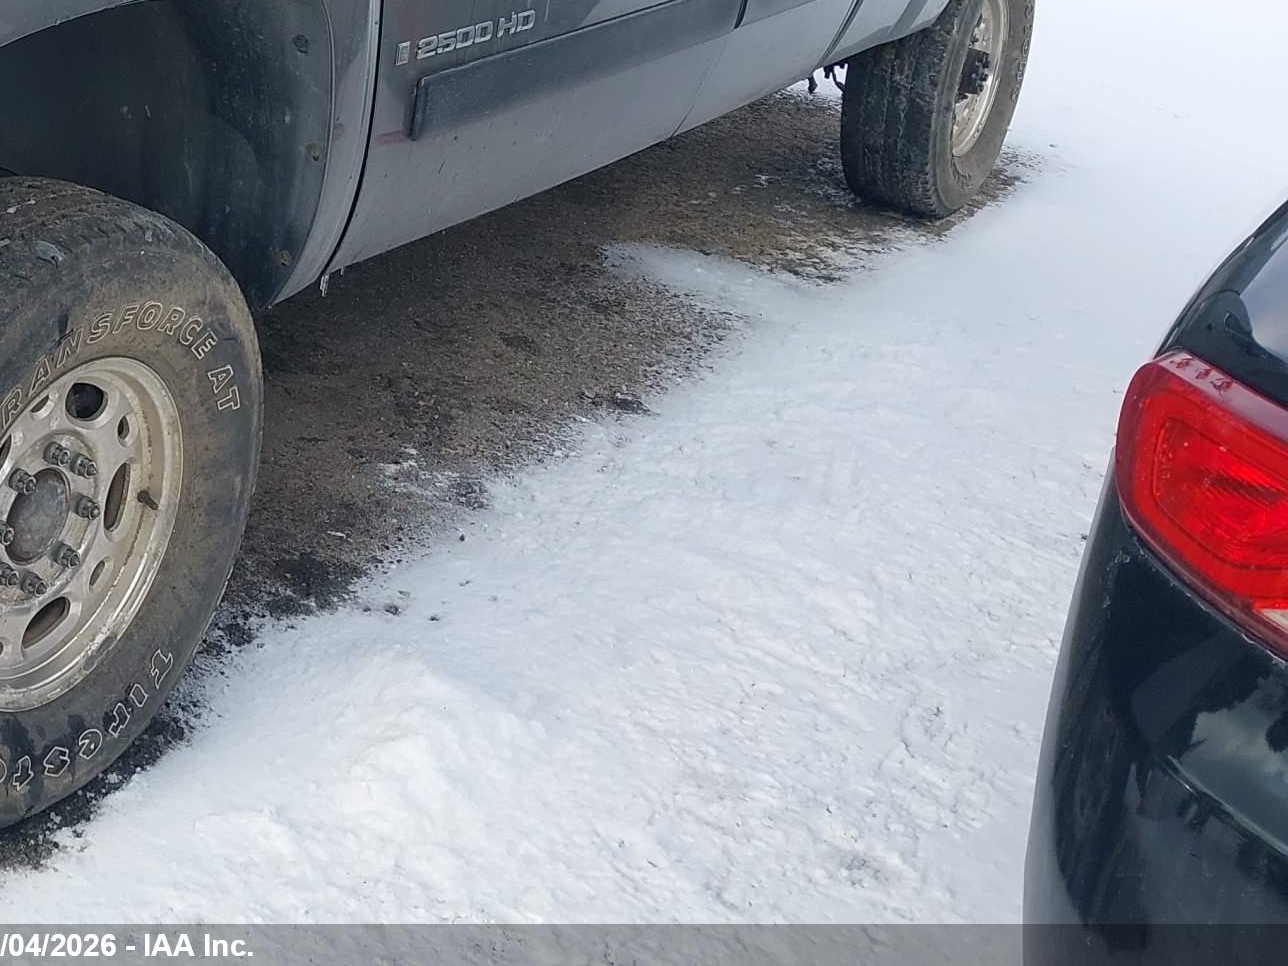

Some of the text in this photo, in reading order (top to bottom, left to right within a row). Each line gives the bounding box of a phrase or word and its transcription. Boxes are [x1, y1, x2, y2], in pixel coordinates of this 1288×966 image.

[416, 9, 536, 60] 2500 HD
[207, 364, 242, 412] AT
